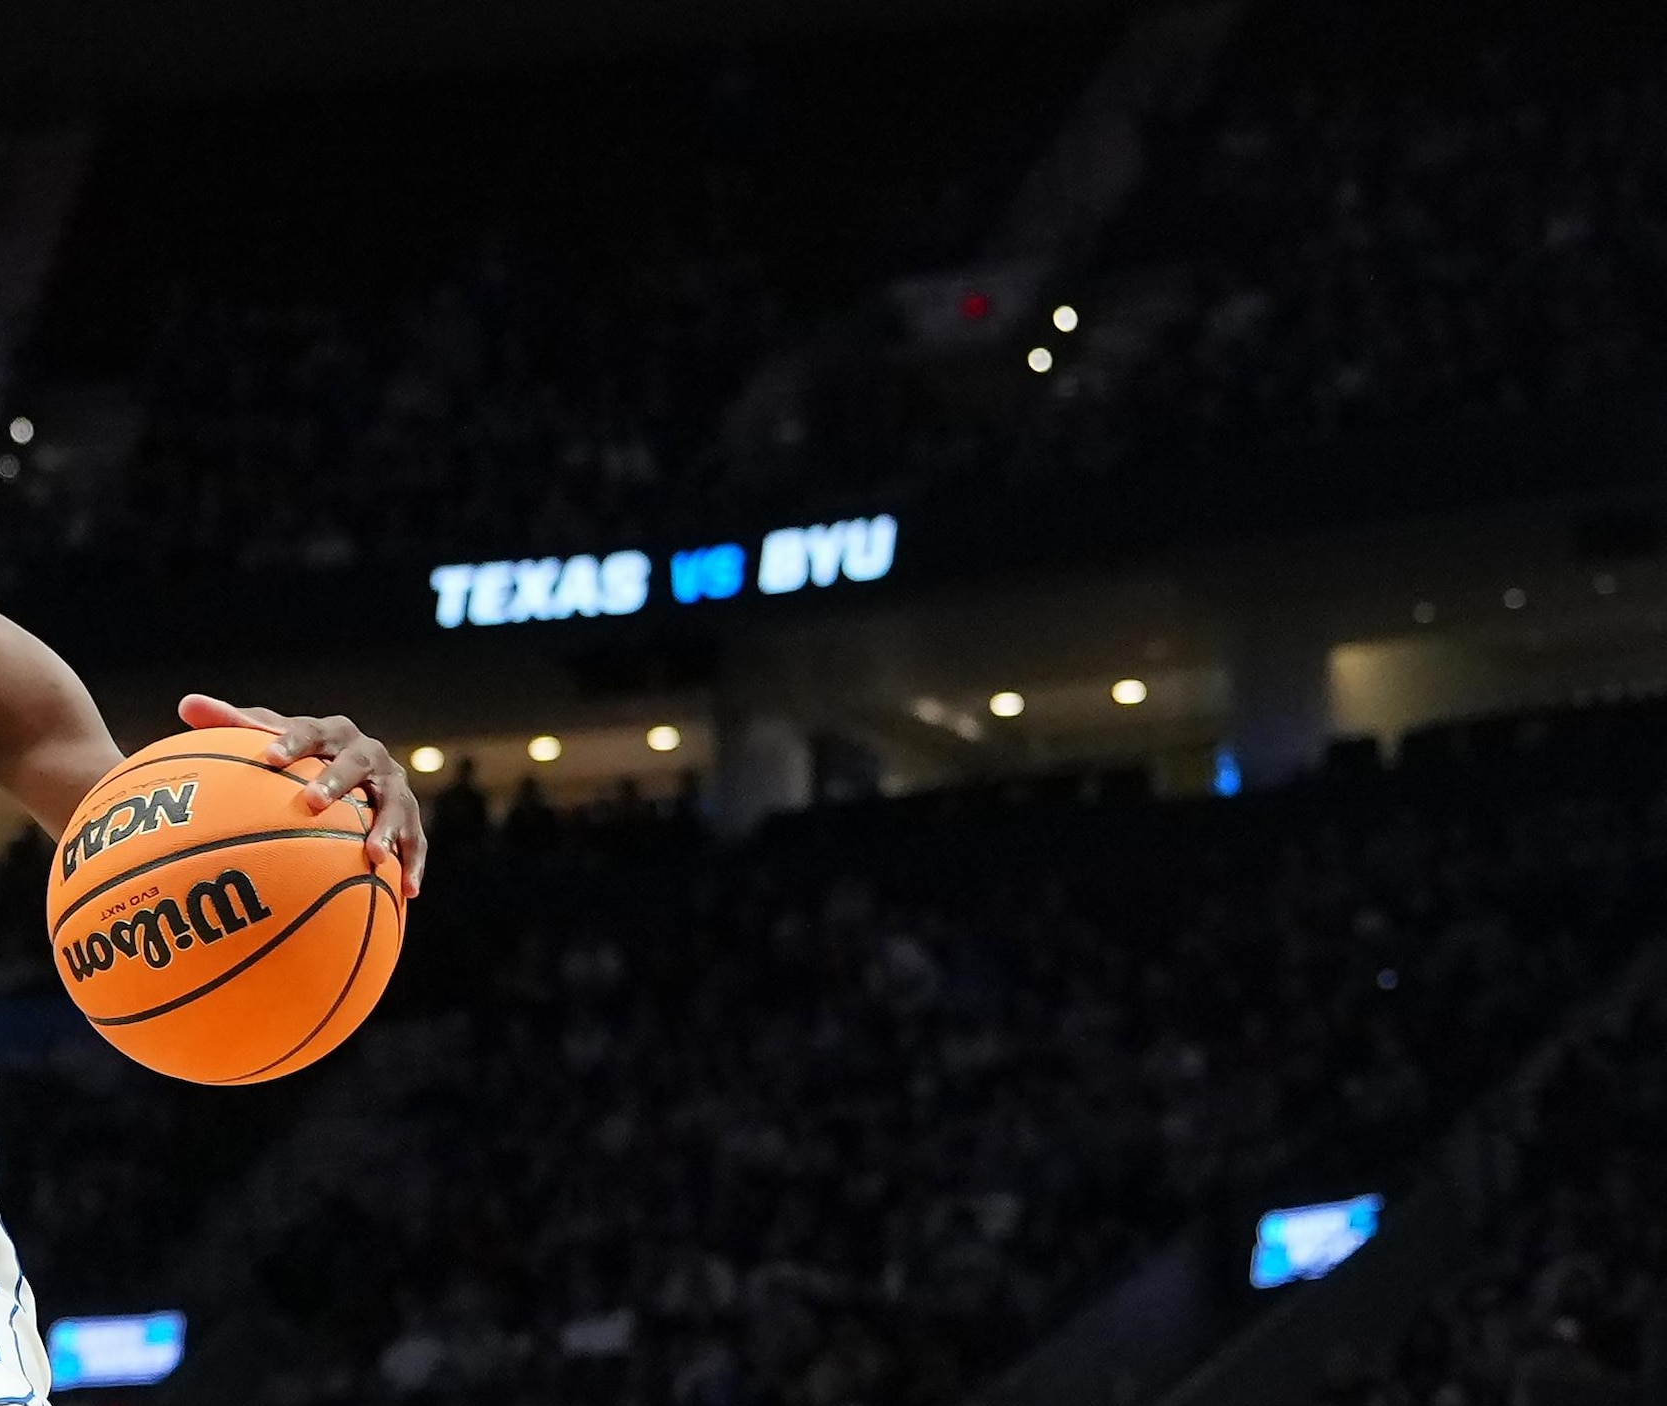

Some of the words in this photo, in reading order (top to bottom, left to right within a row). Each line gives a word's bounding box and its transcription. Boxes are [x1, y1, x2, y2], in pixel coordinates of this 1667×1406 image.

[429, 549, 653, 629] TEXAS
[757, 513, 899, 596] BYU
[63, 780, 200, 882] NCAA
[62, 868, 273, 983] Wilson
[100, 901, 128, 922] NXT
[129, 886, 160, 907] EVO
